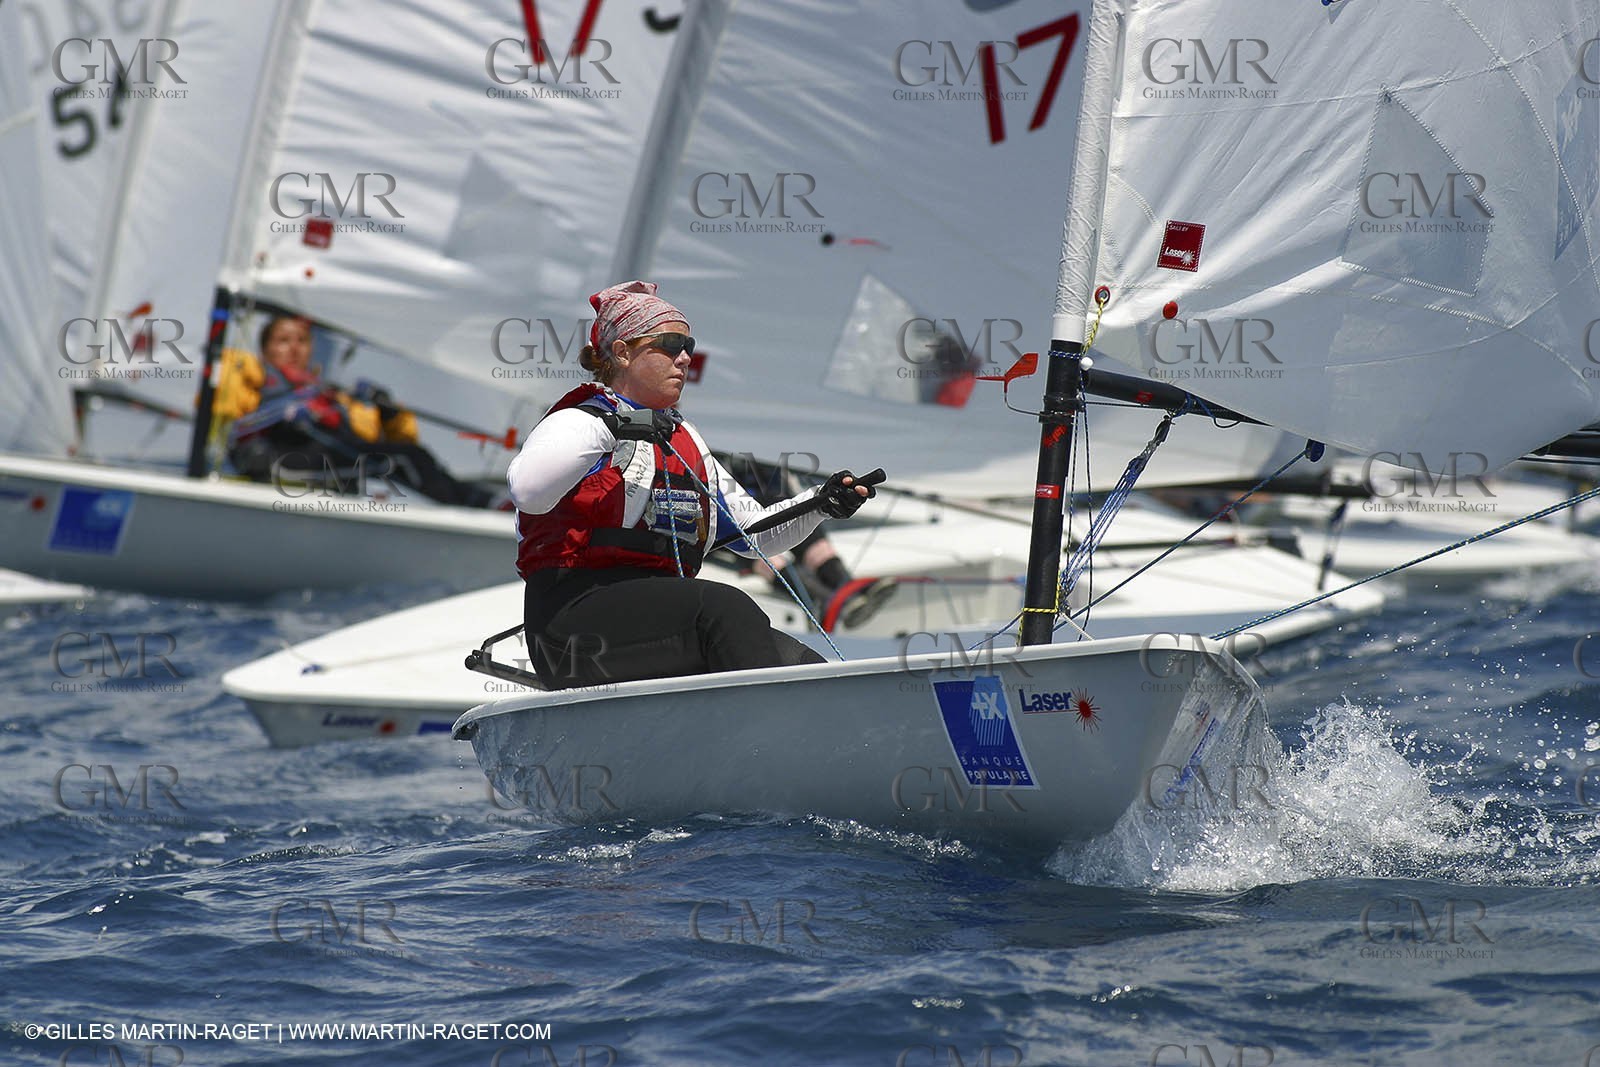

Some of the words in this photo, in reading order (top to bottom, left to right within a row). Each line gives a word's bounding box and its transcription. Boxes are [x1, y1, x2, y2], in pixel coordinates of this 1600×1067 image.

[979, 11, 1080, 144] 17
[1163, 246, 1187, 259] Laser
[1018, 688, 1073, 713] Laser
[961, 754, 1023, 768] BANQUE
[967, 769, 1029, 781] POPULAIRE
